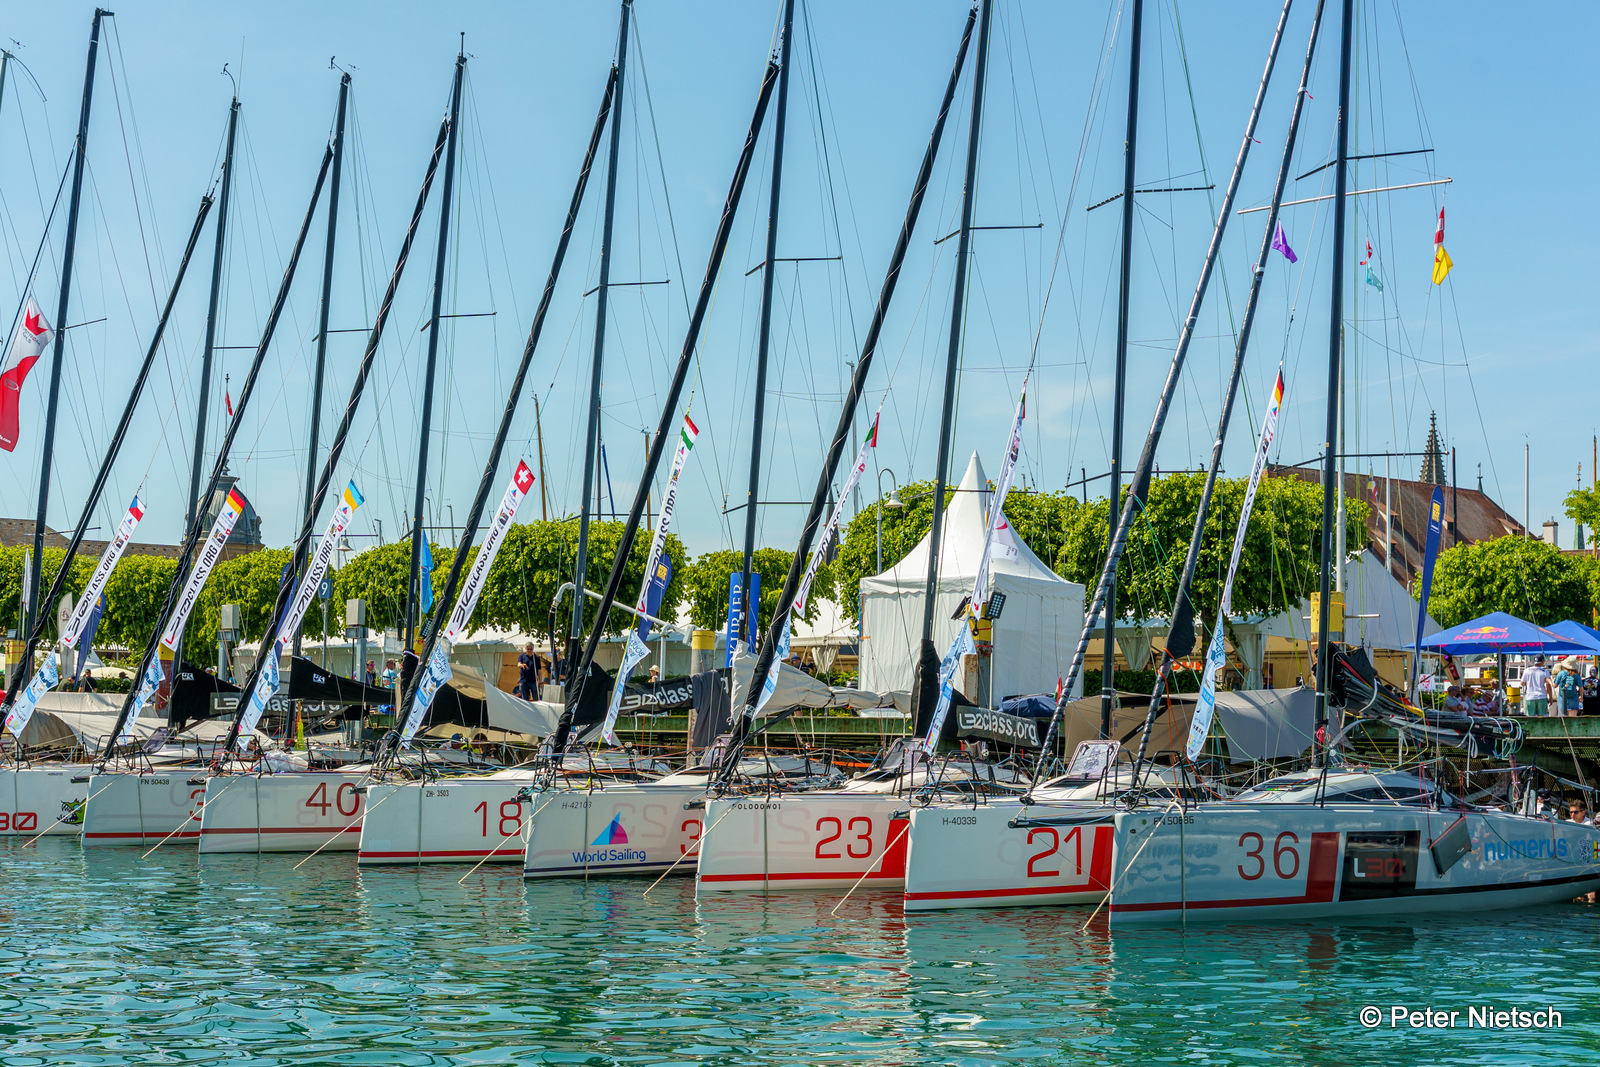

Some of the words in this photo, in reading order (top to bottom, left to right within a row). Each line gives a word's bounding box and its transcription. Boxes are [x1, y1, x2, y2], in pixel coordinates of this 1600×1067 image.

[321, 581, 328, 595] 9
[1482, 632, 1510, 640] Bull
[305, 782, 360, 817] 40
[473, 800, 522, 837] 18
[942, 816, 977, 826] H-40339
[815, 816, 873, 860] 23
[1027, 826, 1082, 878] 21
[1484, 837, 1568, 862] numerus
[572, 849, 608, 863] World
[609, 848, 647, 862] Sailing
[1237, 831, 1300, 881] 36
